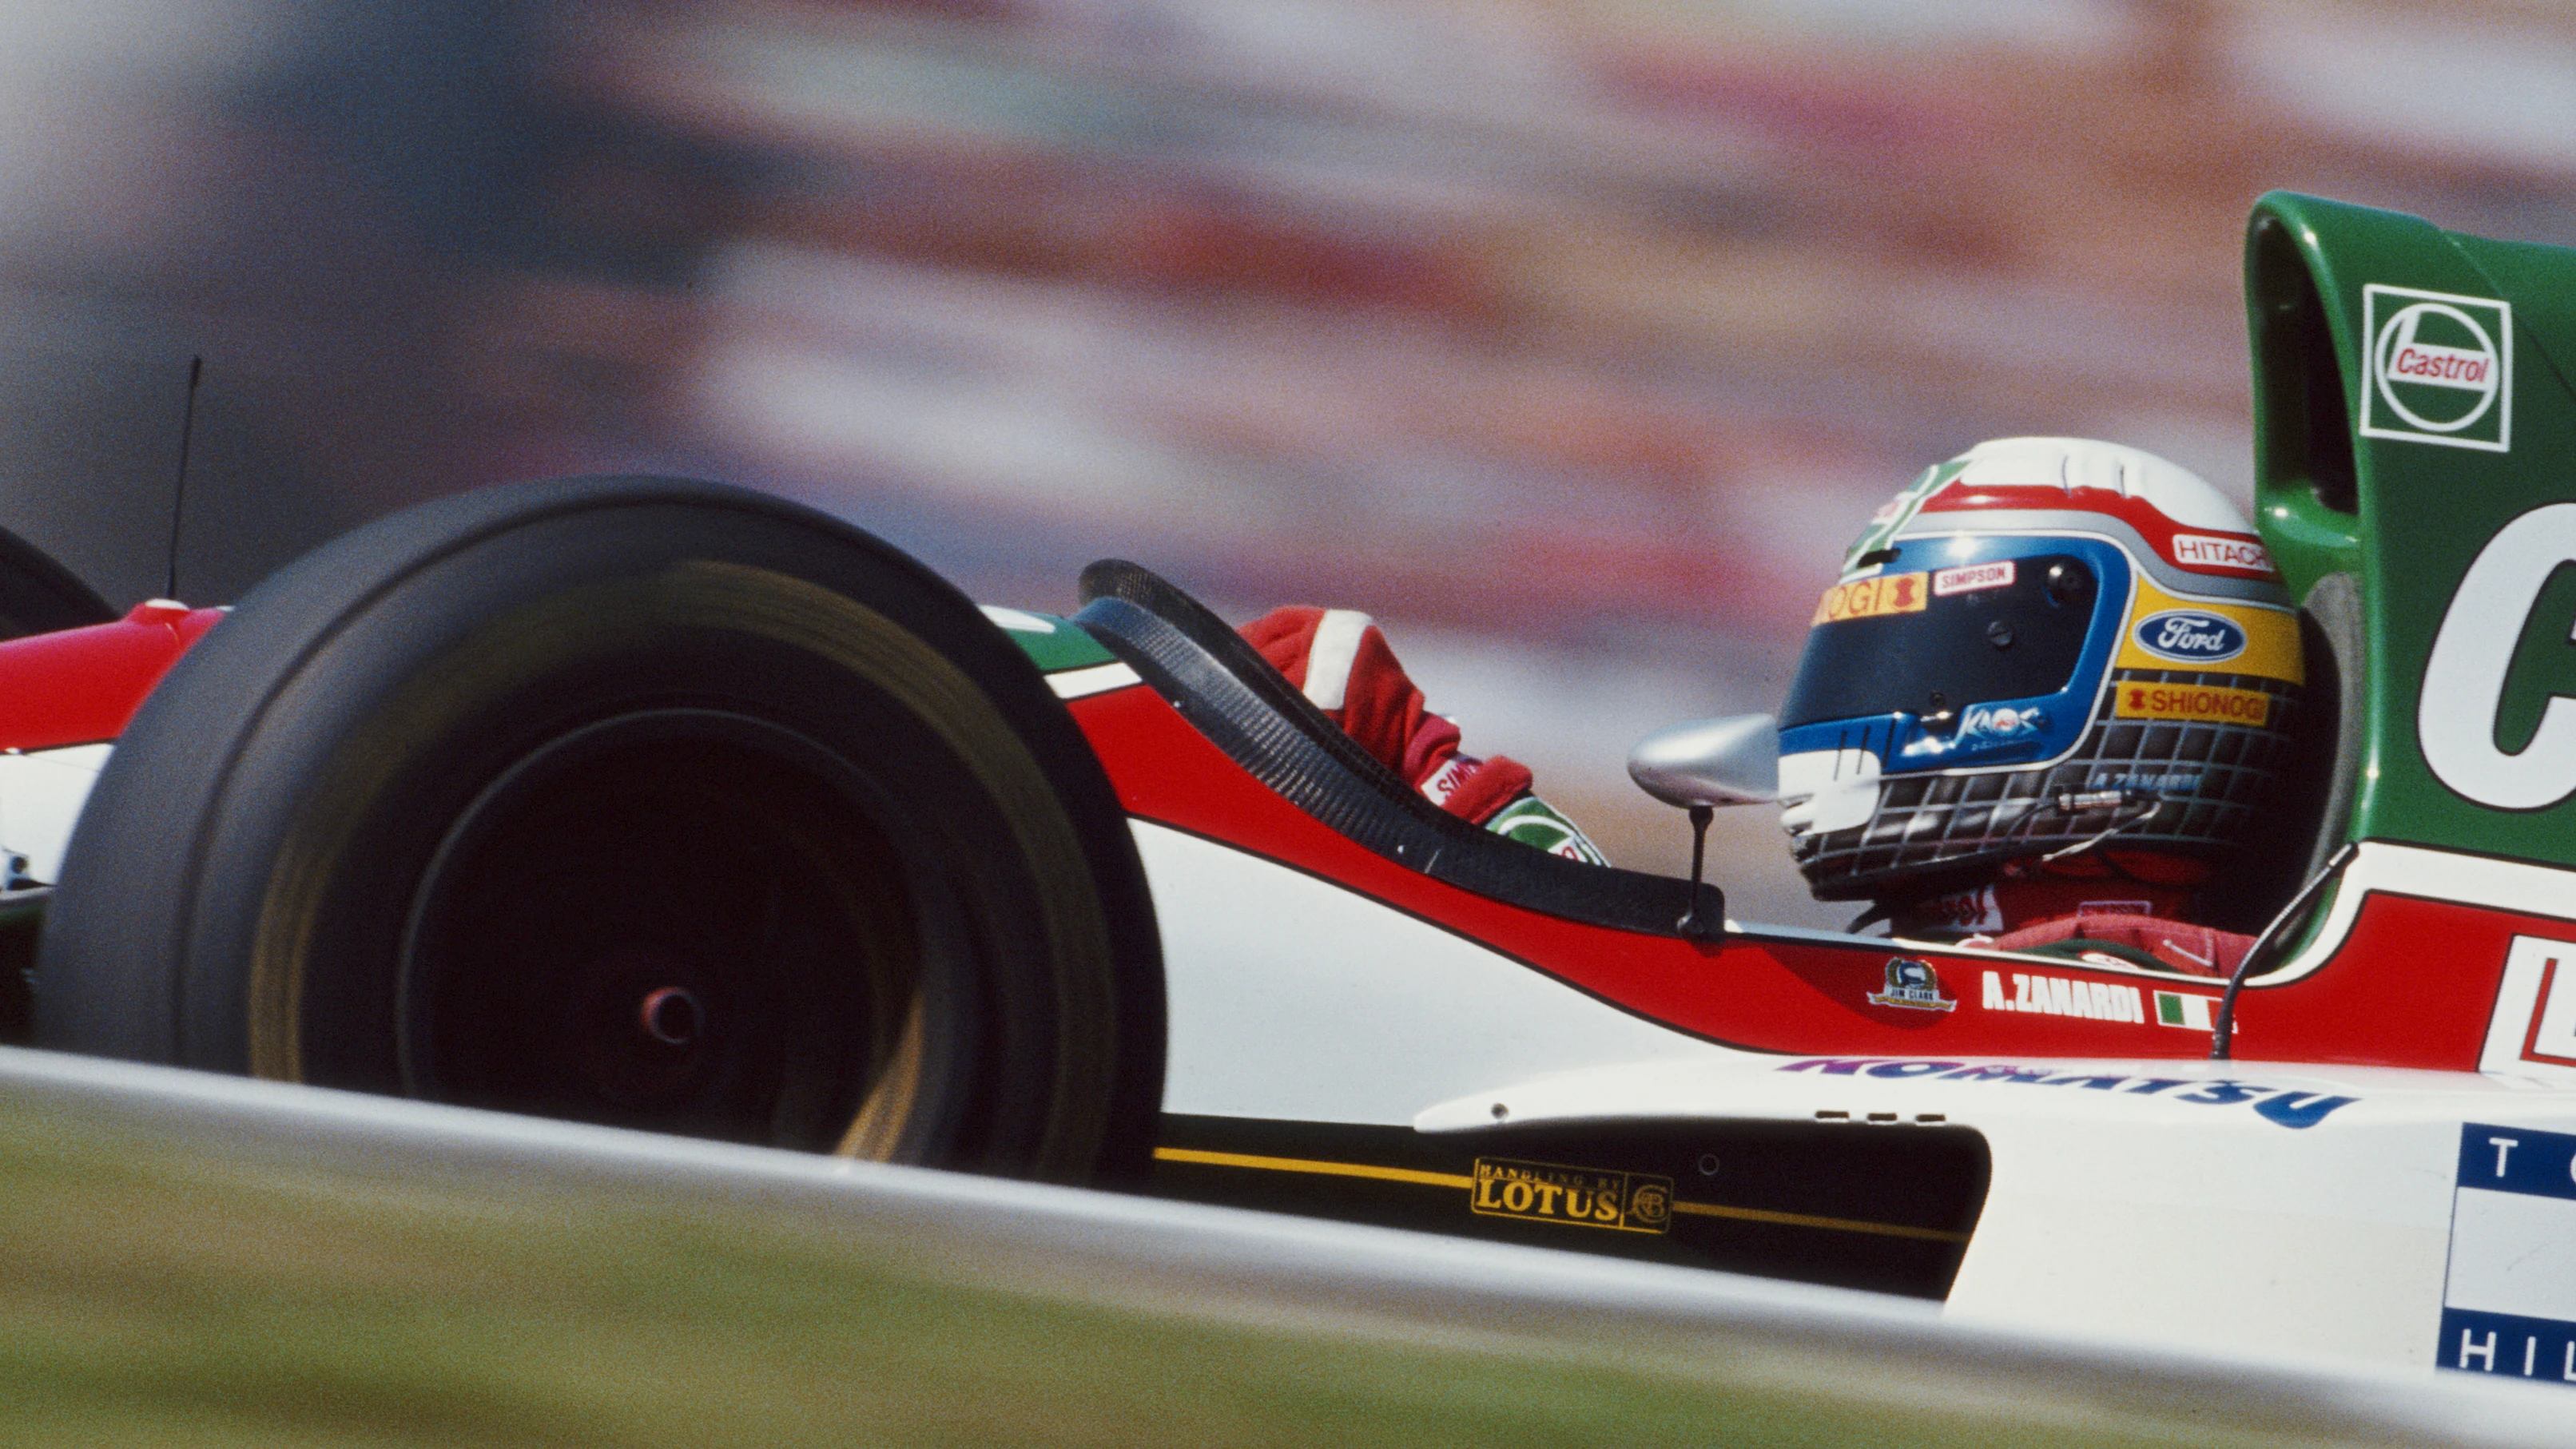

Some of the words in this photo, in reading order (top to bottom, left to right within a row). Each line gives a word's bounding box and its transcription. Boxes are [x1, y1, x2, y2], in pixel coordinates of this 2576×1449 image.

[2398, 347, 2490, 382] Castrol
[1942, 566, 2006, 589] SIMPSON
[2158, 617, 2225, 651] Ford
[1982, 971, 2145, 1024] A.ZANARDI
[1480, 1165, 1584, 1187] HANDLING
[1599, 1177, 1620, 1190] BY
[1476, 1178, 1619, 1221] LOTUS
